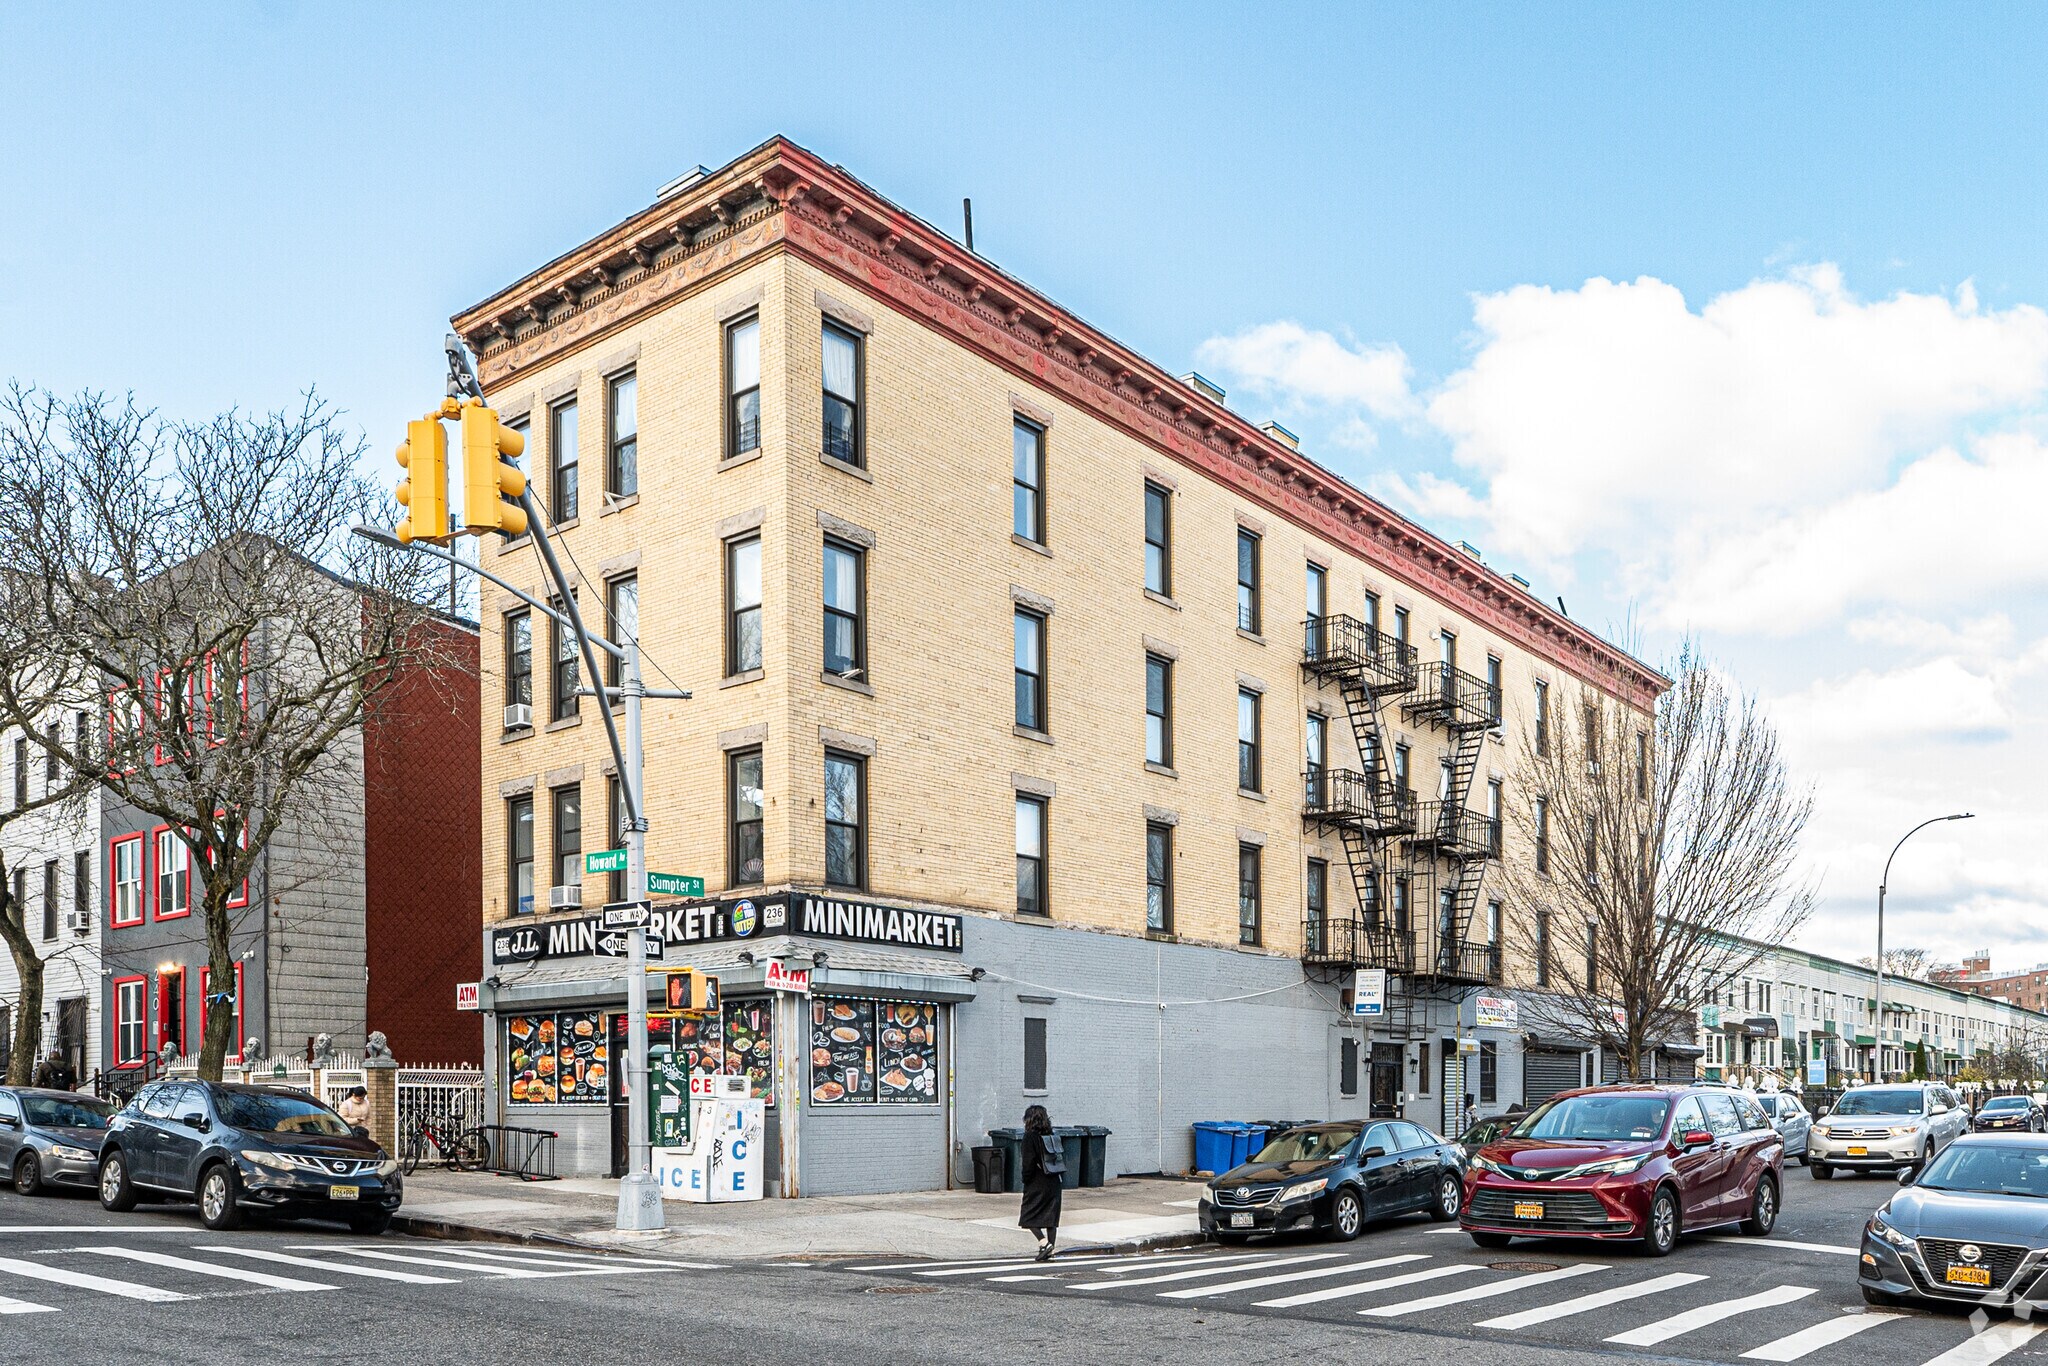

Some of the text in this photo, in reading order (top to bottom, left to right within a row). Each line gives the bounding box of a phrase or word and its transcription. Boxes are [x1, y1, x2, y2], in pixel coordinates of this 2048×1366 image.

[589, 854, 617, 870] Howard
[650, 875, 700, 893] Sumpter St
[609, 909, 645, 923] ONE WAY
[766, 907, 783, 919] 236
[511, 905, 716, 955] J.L. MINRKET
[803, 899, 956, 947] MINIMARKET
[605, 939, 626, 950] ONE
[459, 986, 477, 1002] ATM
[691, 1078, 712, 1093] CE
[732, 1110, 747, 1191] ICE
[660, 1166, 701, 1189] ICE
